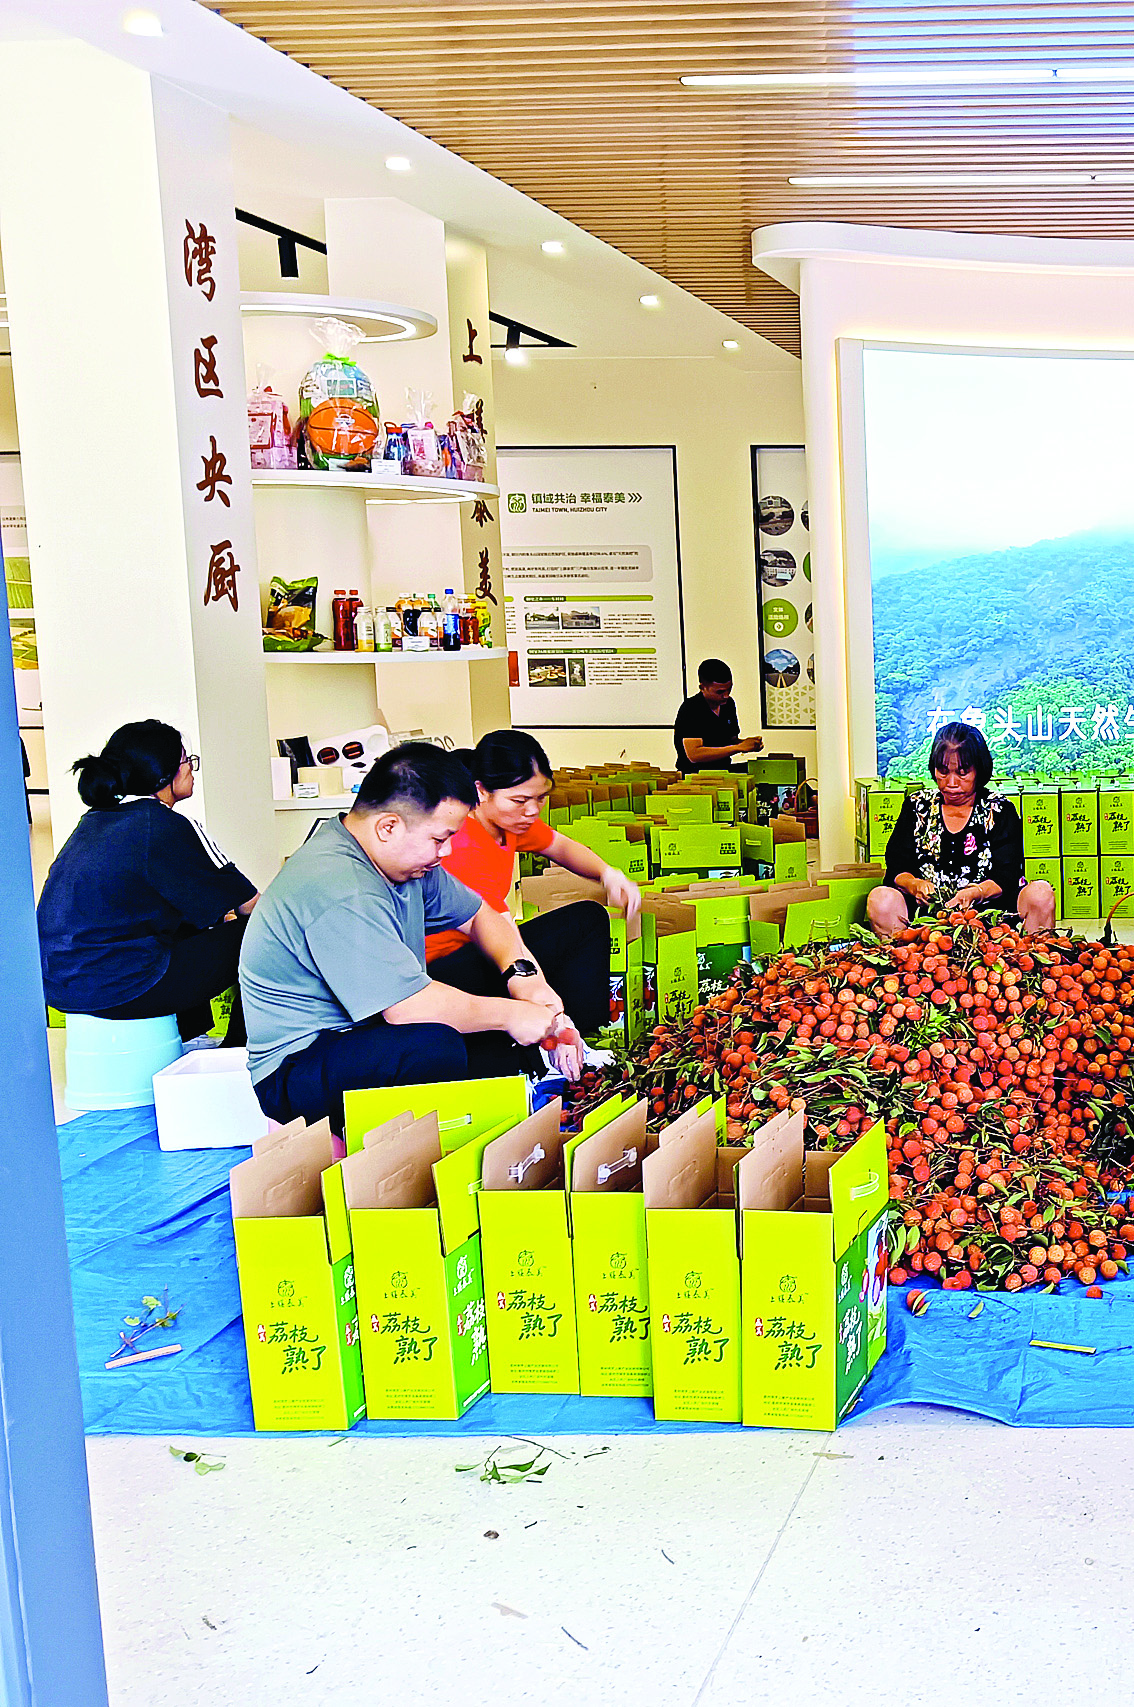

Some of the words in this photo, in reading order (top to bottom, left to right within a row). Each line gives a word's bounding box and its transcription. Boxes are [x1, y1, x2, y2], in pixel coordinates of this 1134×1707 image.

[183, 218, 242, 613] 湾区央厨
[531, 492, 577, 504] 镇域共治
[580, 492, 626, 504] 幸福泰美
[507, 1290, 555, 1311] 荔枝
[598, 1292, 647, 1313] 荔枝
[268, 1321, 318, 1344] 荔枝
[381, 1312, 430, 1334] 荔枝
[519, 1312, 562, 1340] 熟了
[610, 1315, 650, 1343] 熟了
[672, 1312, 722, 1334] 荔枝
[764, 1316, 815, 1338] 荔枝
[282, 1345, 326, 1374] 熟了
[394, 1335, 437, 1364] 熟了
[684, 1336, 729, 1365] 熟了
[775, 1341, 822, 1370] 熟了
